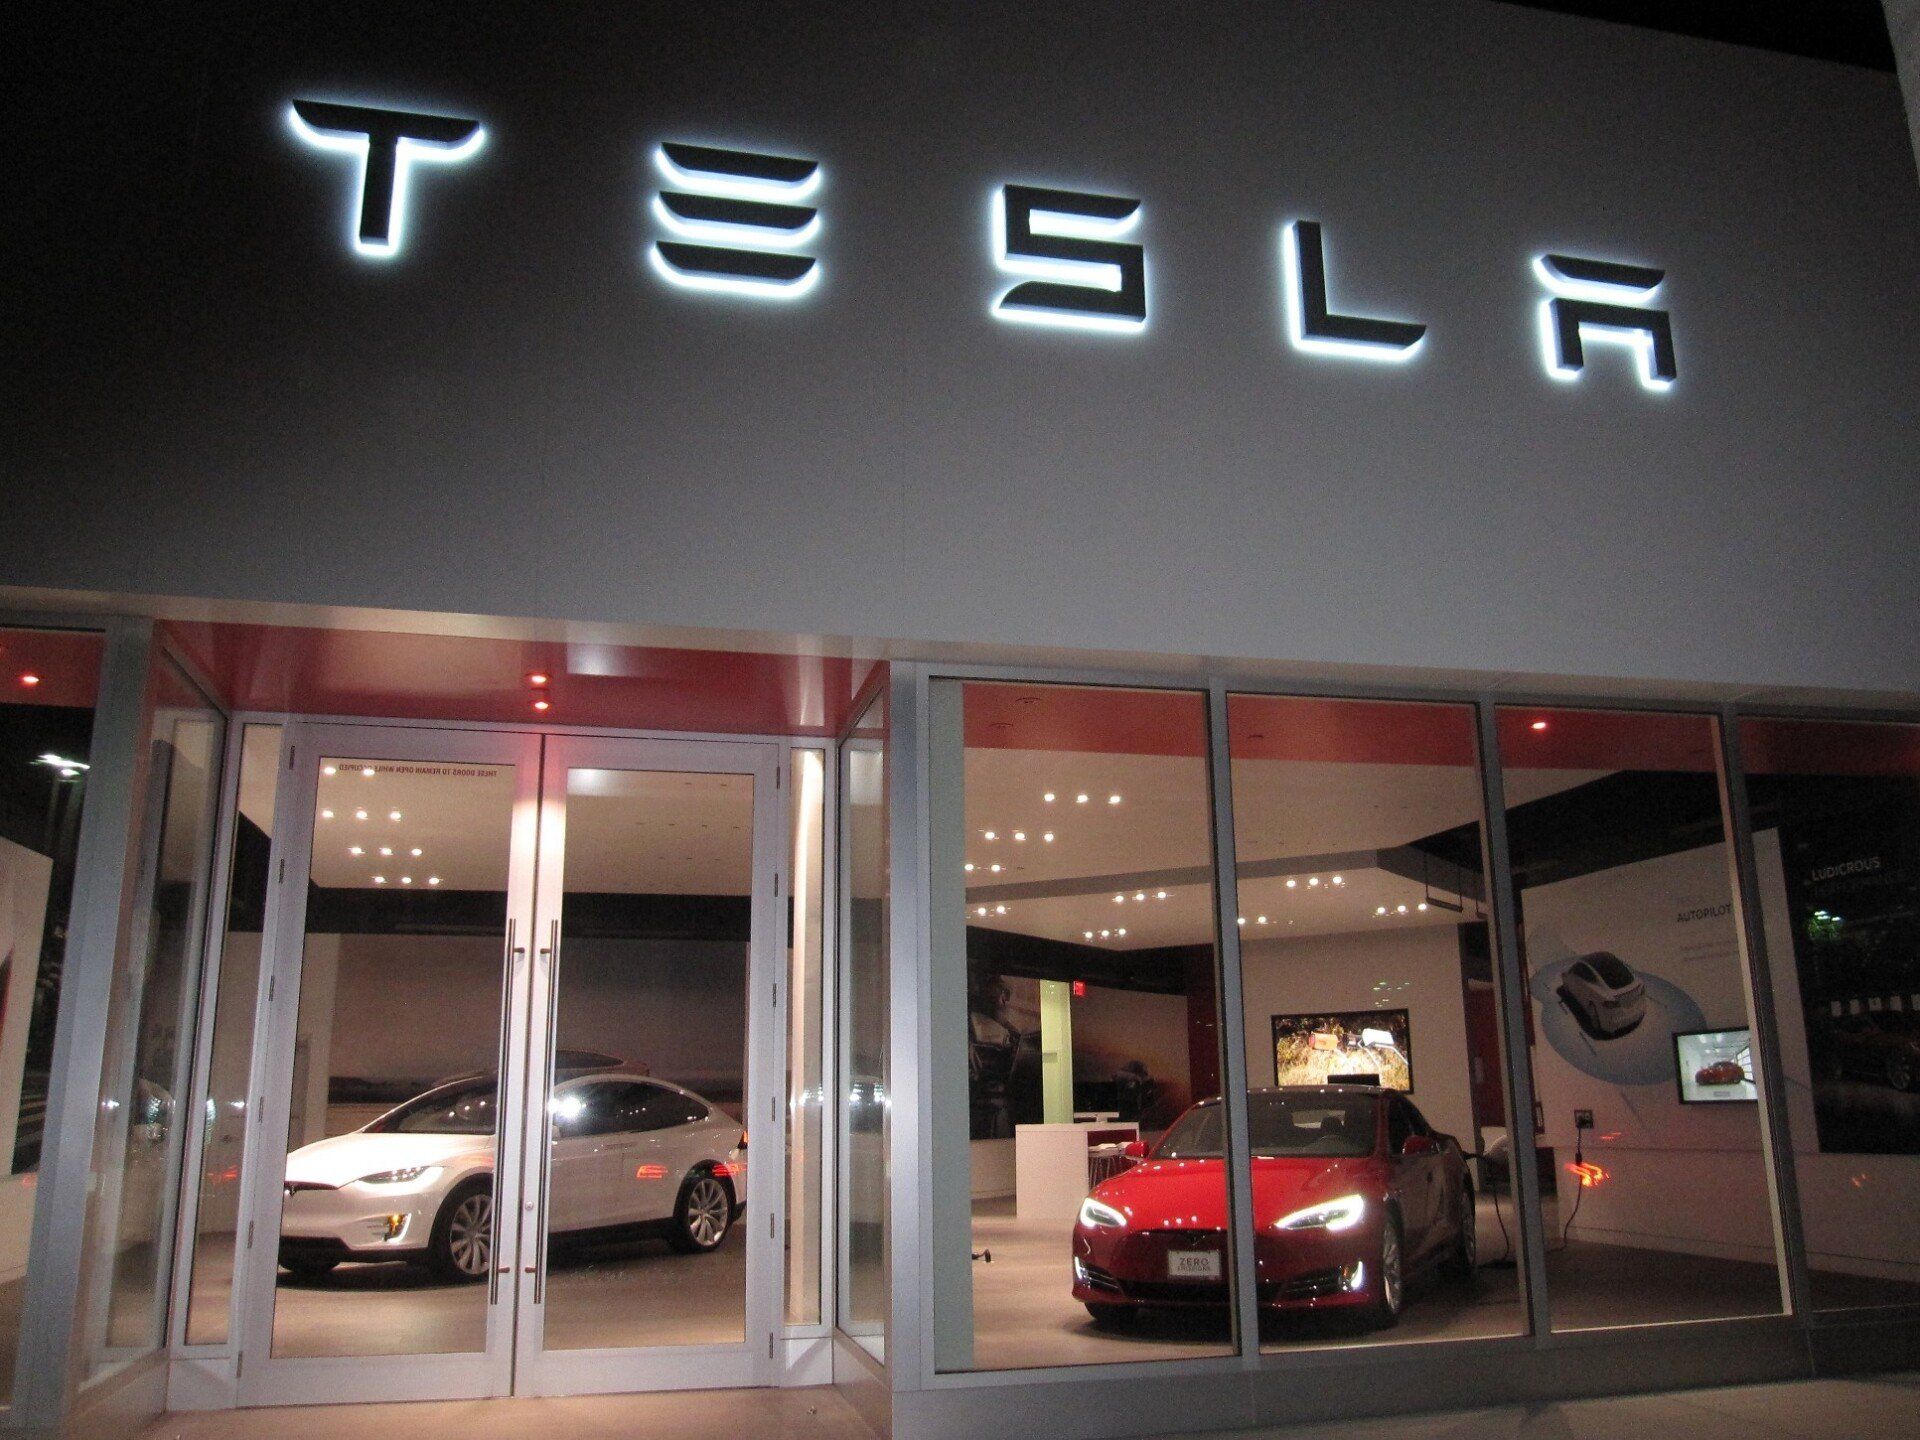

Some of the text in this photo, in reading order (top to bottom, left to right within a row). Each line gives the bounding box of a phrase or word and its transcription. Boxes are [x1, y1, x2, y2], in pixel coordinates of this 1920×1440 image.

[284, 97, 1680, 391] TESLA
[1811, 856, 1881, 881] LUDICROUS
[1677, 903, 1731, 922] AUTOPILOT
[1179, 1257, 1209, 1266] ZERO
